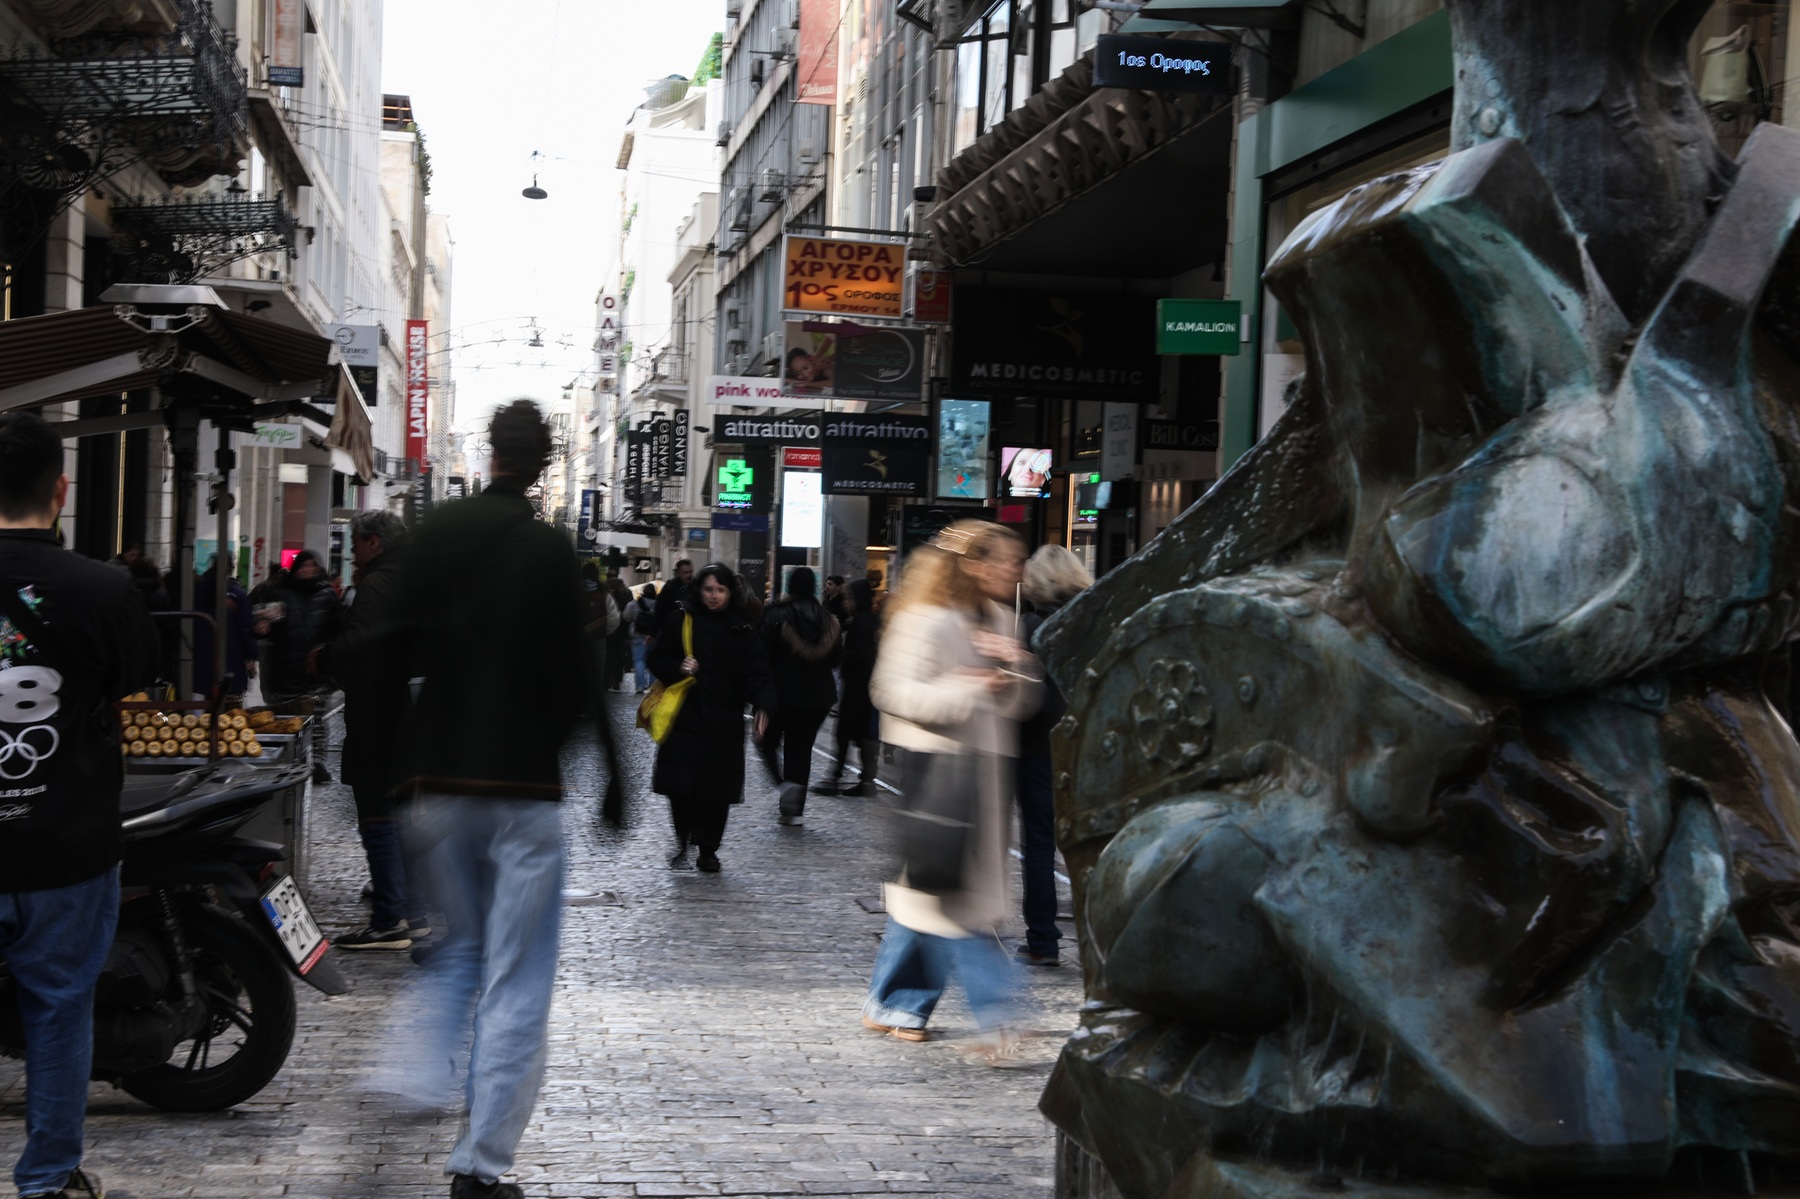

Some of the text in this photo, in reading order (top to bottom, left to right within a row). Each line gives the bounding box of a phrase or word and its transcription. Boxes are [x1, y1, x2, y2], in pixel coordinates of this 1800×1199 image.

[799, 241, 892, 264] ΑΓΟΡΑ
[788, 259, 901, 283] ΧΡΥΣΟΥ
[843, 289, 901, 302] ΟΡΟΦΟΣ
[830, 303, 900, 315] ΕΡΜΟΥ 14
[1165, 321, 1237, 333] KAMALION
[410, 326, 426, 437] LAPIN HOUSE
[969, 362, 1144, 386] MEDICOSMETIC
[715, 381, 751, 399] pink
[724, 419, 821, 440] attrattivo
[825, 420, 930, 440] attrattivo
[1150, 424, 1179, 445] Bill
[658, 422, 671, 478] MANGO
[674, 412, 688, 473] MANGO
[832, 479, 917, 490] MEDICOSMETIC
[718, 492, 752, 502] PHARMACY
[635, 559, 651, 570] JD
